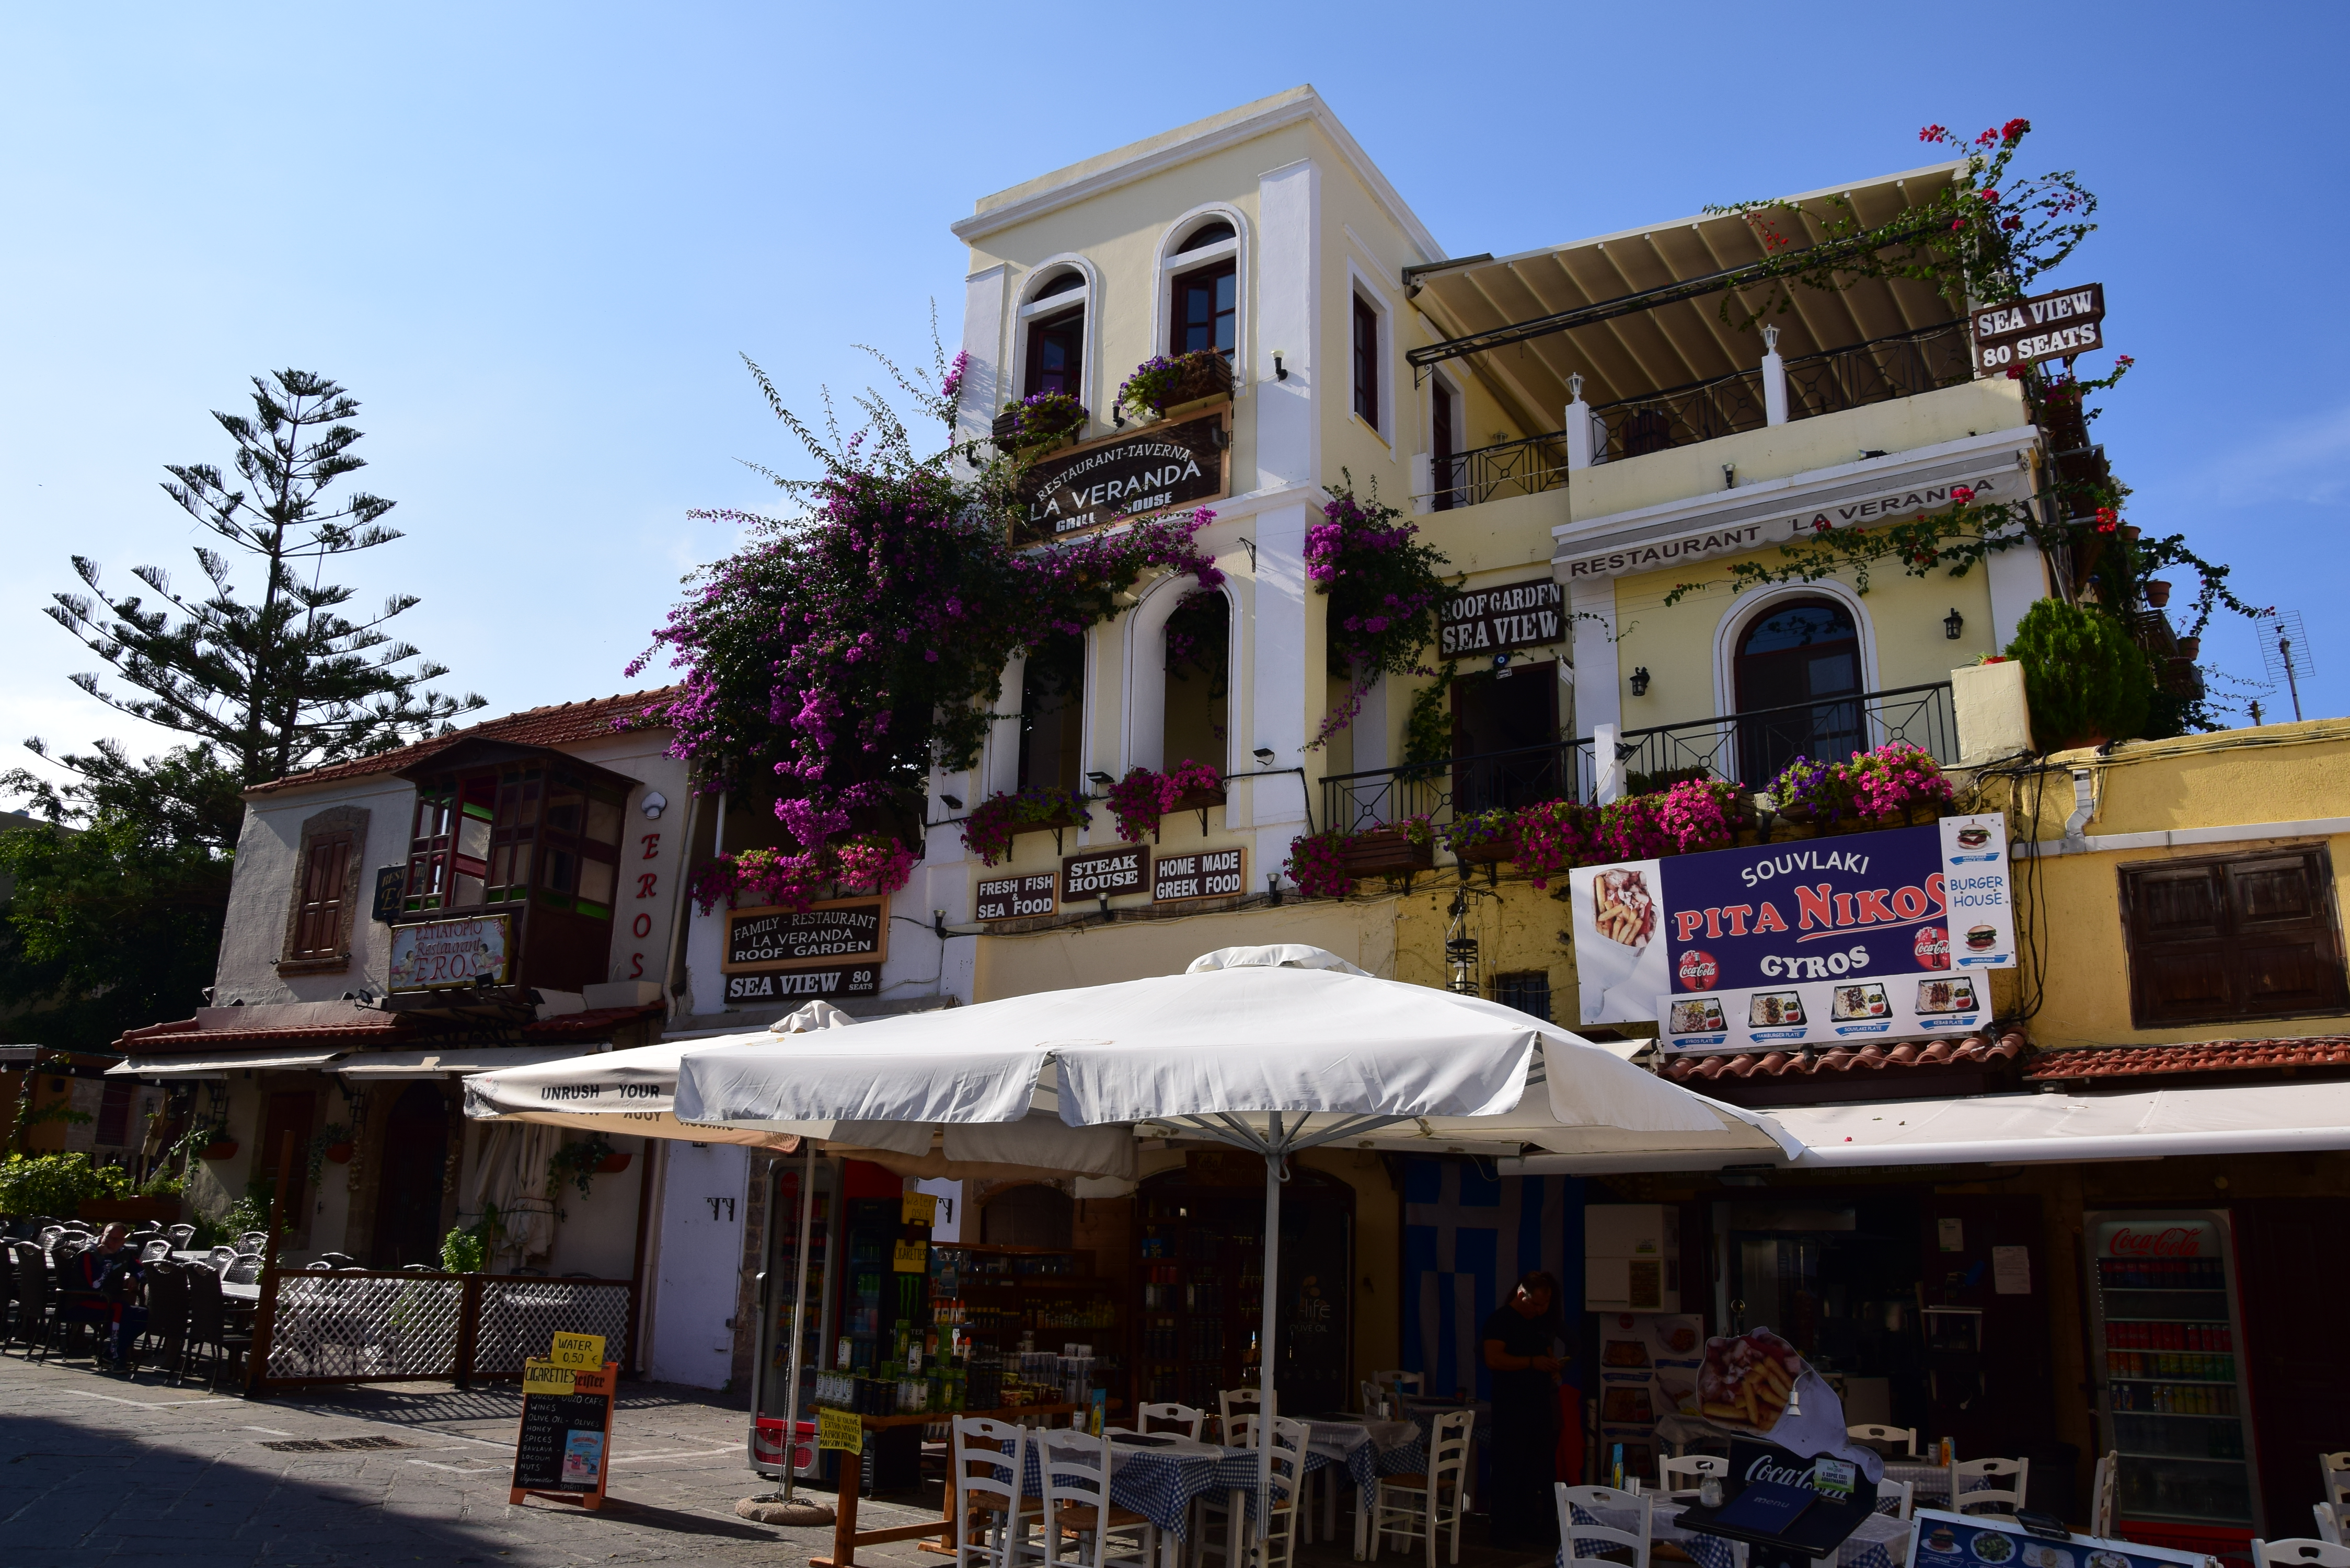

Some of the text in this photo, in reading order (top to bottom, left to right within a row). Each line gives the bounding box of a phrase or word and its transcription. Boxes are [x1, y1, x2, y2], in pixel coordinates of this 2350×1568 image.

[1978, 290, 2092, 337] SEA VIEW
[1983, 323, 2096, 367] 80 SEATS
[1030, 460, 1202, 522] LA VERANDA
[1055, 512, 1096, 533] GRILL
[1570, 526, 1761, 578] RESTAURANT
[1490, 584, 1561, 614] GARDEN
[1442, 610, 1558, 653] SEA VIEW
[1070, 855, 1138, 878] STEAK
[1159, 852, 1238, 878] HOME MADE
[1741, 851, 1869, 887] SOUVLAKI
[979, 874, 1054, 896] FRESH FISH
[1068, 870, 1138, 893] HOUSE
[1156, 874, 1240, 899] GREEK FOOD
[1950, 876, 2003, 891] BURGER
[629, 833, 661, 979] EROS
[978, 897, 1053, 919] SEA FOOD
[1674, 872, 1948, 941] PITA NIKOS
[1954, 892, 2002, 907] HOUSE
[734, 917, 780, 941] FAMILY
[792, 912, 877, 929] RESTAURANT
[415, 937, 481, 956] Restaurant
[753, 928, 853, 947] LA VERANDA
[735, 940, 871, 961] ROOF GARDEN
[414, 953, 480, 982] EROS
[1679, 962, 1716, 978] Coca-Cola
[1760, 946, 1870, 979] GYROS
[730, 971, 871, 997] SEA VIEW 80
[541, 1084, 660, 1100] UNRUSH YOUR
[1811, 1168, 1847, 1177] Draught
[1882, 1165, 1908, 1173] Lamb
[2110, 1228, 2203, 1255] Coca-Cola
[895, 1248, 926, 1261] CIGARETTES
[558, 1339, 593, 1352] WATER
[525, 1367, 575, 1383] CIGARETTES
[531, 1403, 556, 1412] WINES
[528, 1414, 549, 1422] OLIVE
[574, 1418, 600, 1427] OLIVES
[825, 1421, 842, 1431] EXTRA
[524, 1434, 552, 1443] SPICES
[821, 1429, 857, 1443] FABRICATION
[520, 1463, 540, 1471] NUTS
[1745, 1455, 1847, 1500] Coca-C
[1753, 1496, 1790, 1508] menu
[1928, 1555, 1950, 1564] HAMBURGER
